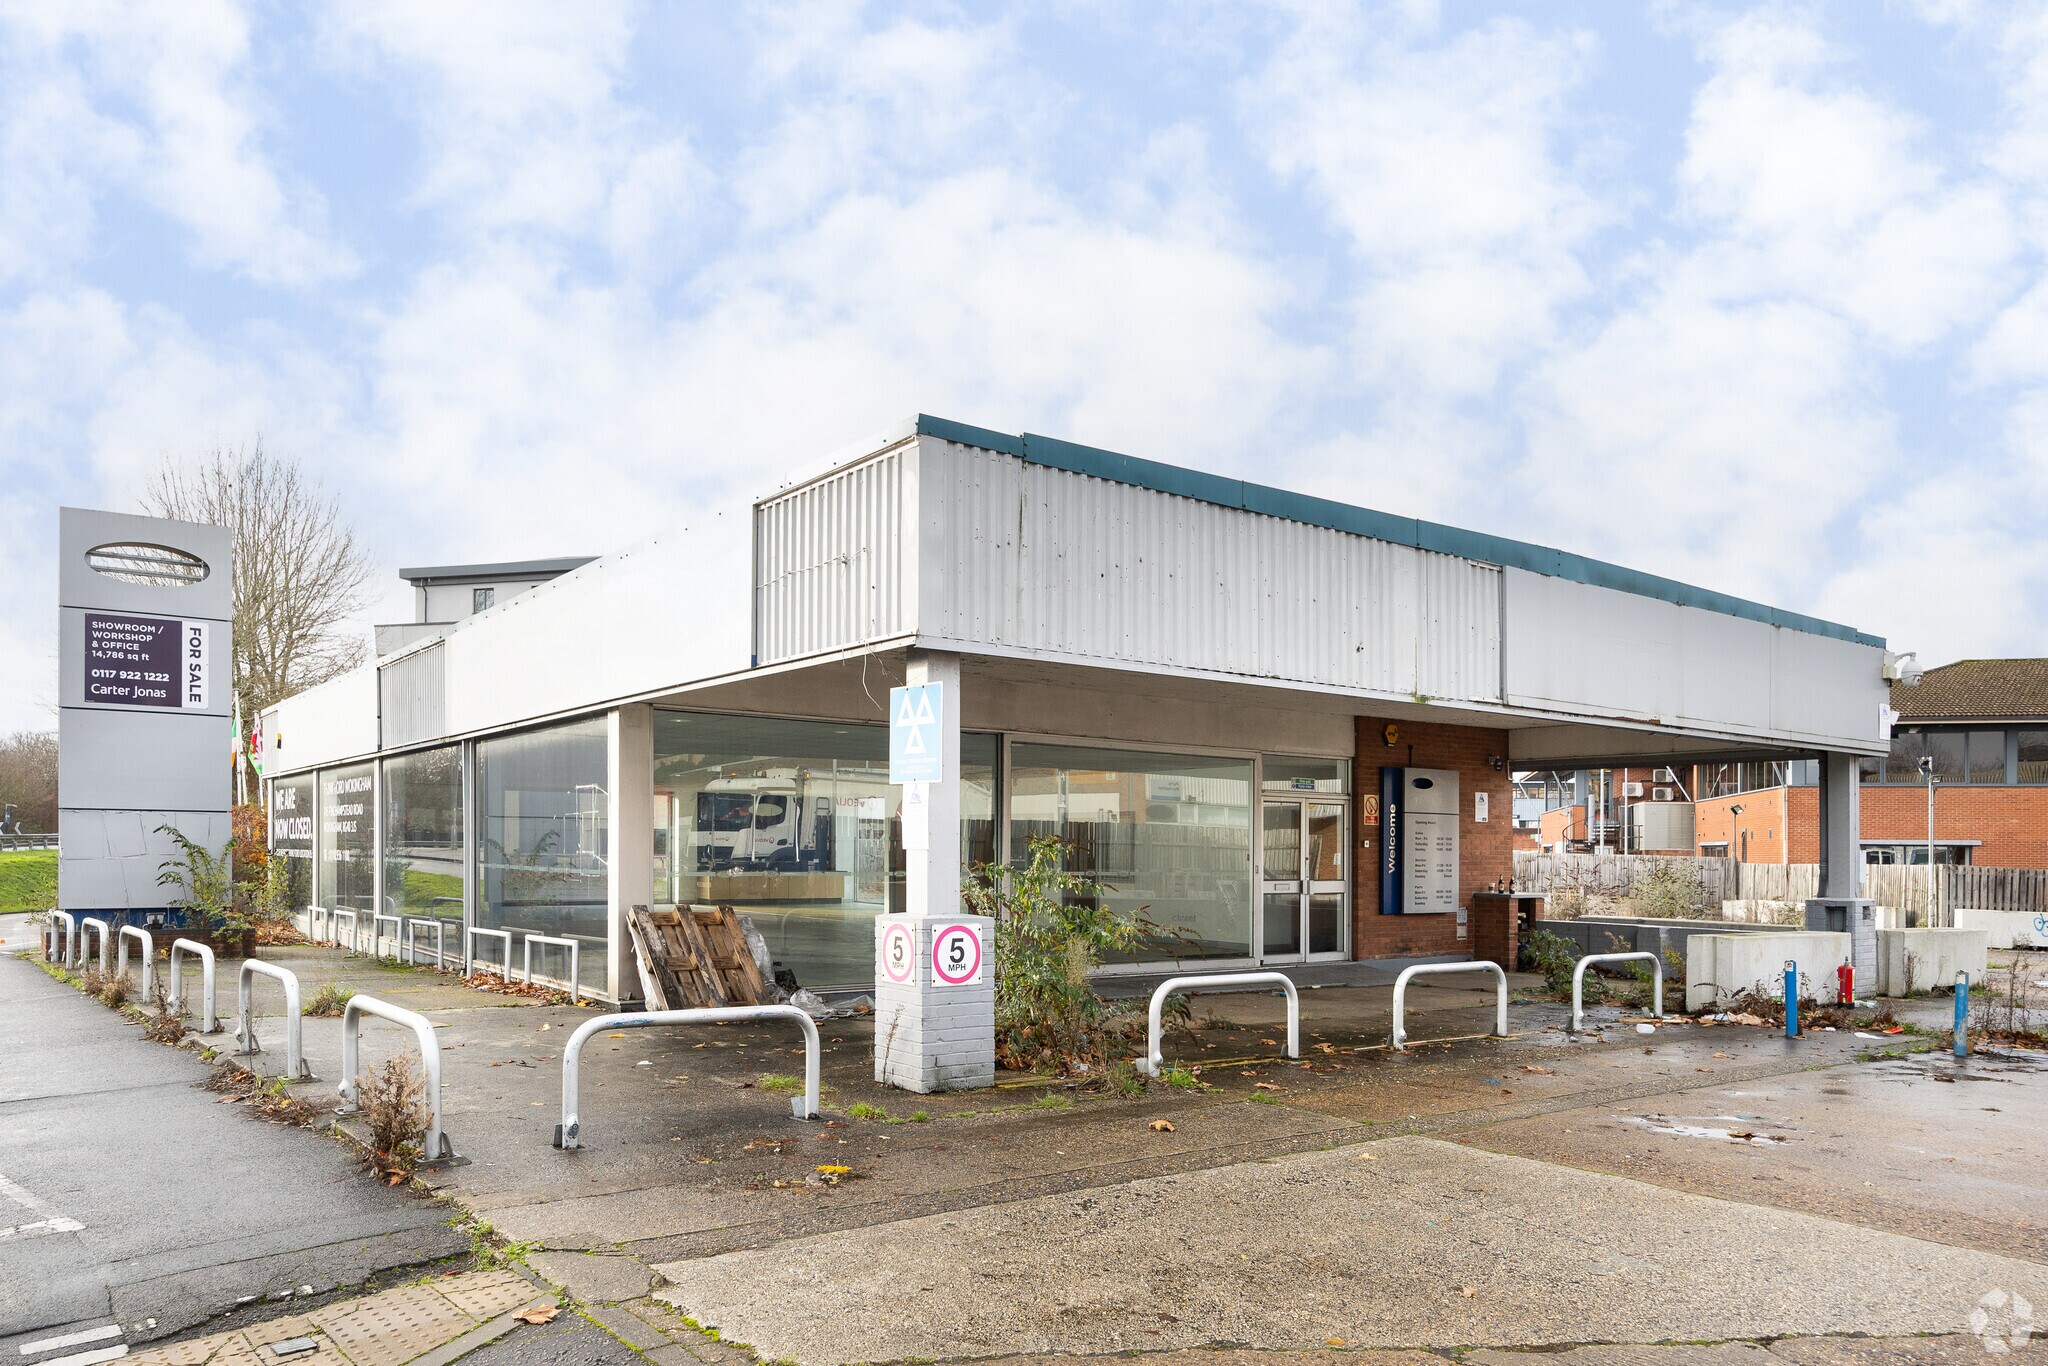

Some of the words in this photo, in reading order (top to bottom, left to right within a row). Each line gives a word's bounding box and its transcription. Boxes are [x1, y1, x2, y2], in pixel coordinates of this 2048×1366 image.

[92, 621, 155, 633] SHOWROOM
[158, 626, 164, 634] /
[92, 631, 153, 642] WORKSHOP
[189, 627, 202, 659] FOR
[102, 641, 140, 651] OFFICE
[92, 650, 124, 660] 14,786
[127, 653, 139, 661] sq
[141, 653, 150, 661] ft
[91, 669, 117, 678] 0117
[119, 670, 141, 680] 922
[144, 672, 170, 682] 1222
[189, 663, 202, 703] SALE
[91, 683, 130, 696] Carter
[132, 685, 167, 698] Jonas
[275, 789, 285, 811] WE
[284, 788, 296, 810] ARE
[275, 818, 289, 840] NOW
[289, 816, 313, 840] CLOSED.
[1388, 803, 1397, 874] Welcome
[893, 936, 904, 961] 5
[949, 937, 965, 963] 5
[892, 961, 905, 970] MPH
[948, 963, 967, 972] MPH
